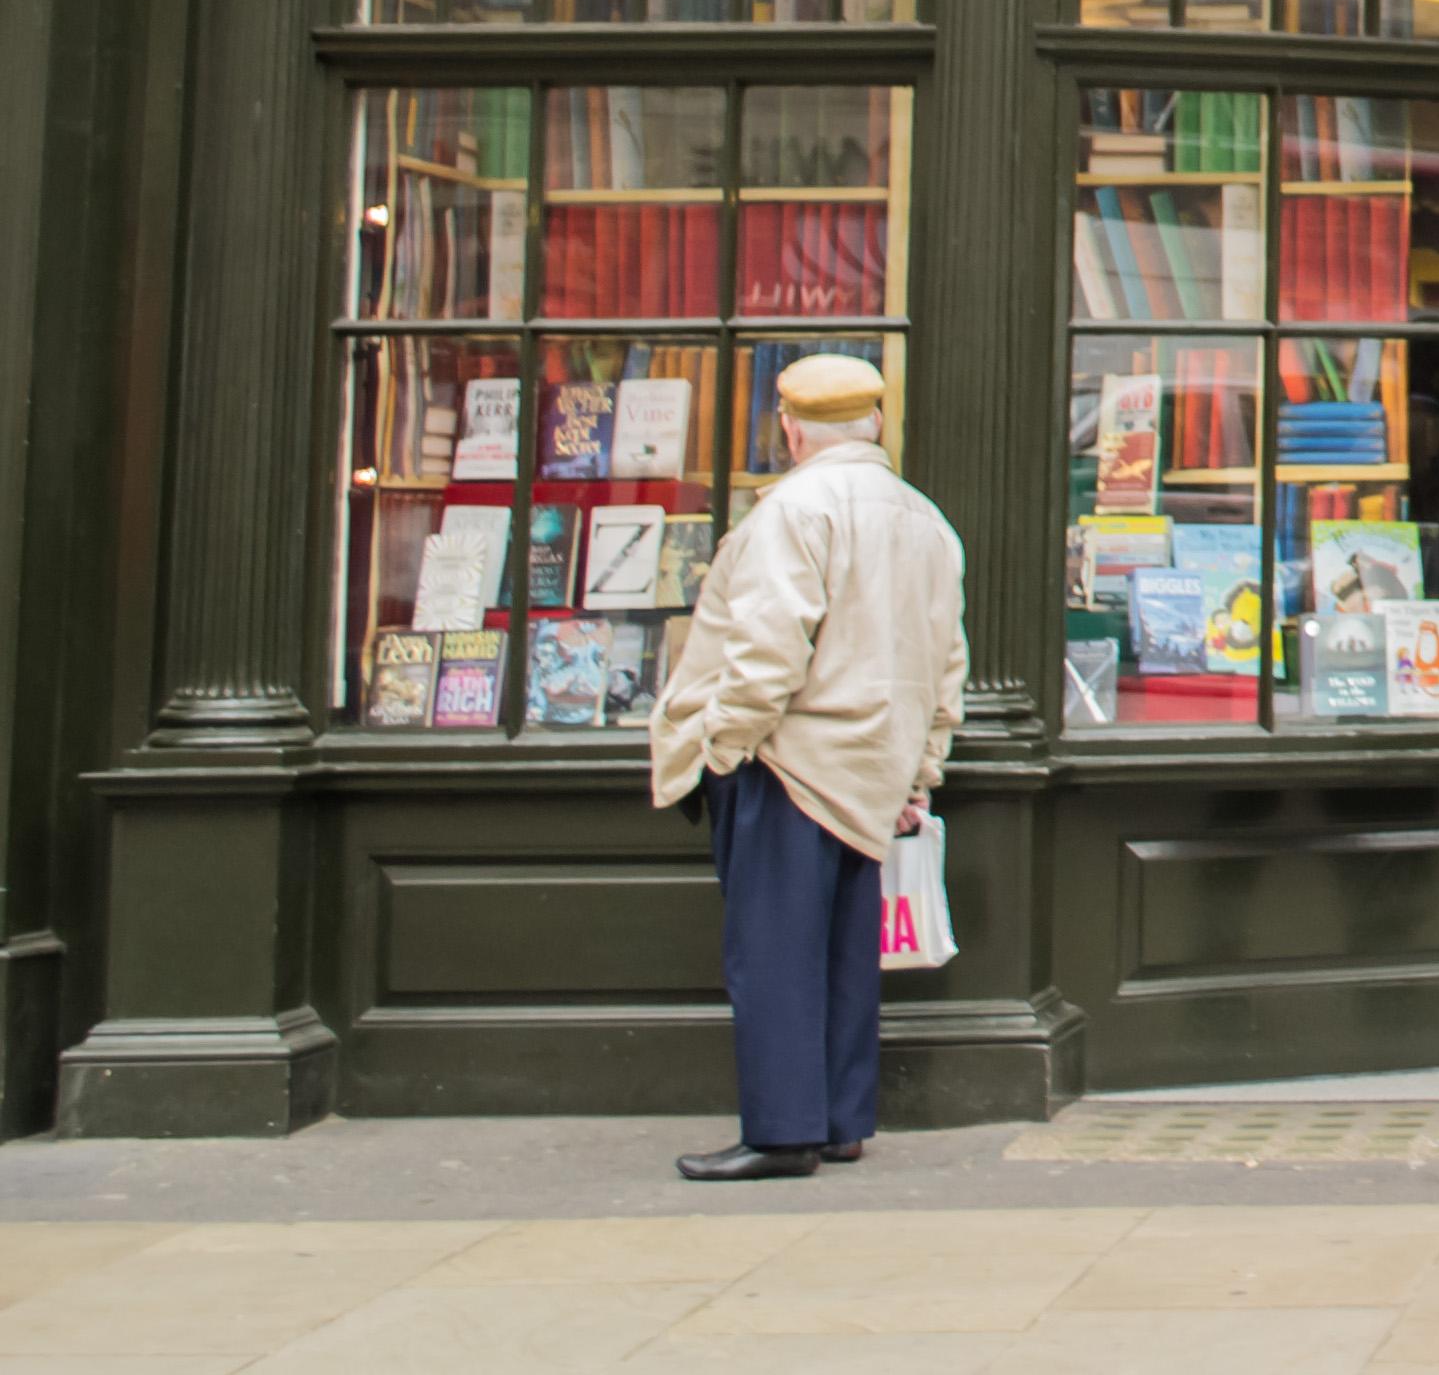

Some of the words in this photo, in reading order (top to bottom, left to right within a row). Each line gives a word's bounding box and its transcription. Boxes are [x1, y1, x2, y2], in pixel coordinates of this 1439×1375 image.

[625, 403, 677, 422] Vine
[1139, 576, 1201, 595] BIGGLES
[436, 689, 494, 713] RICH
